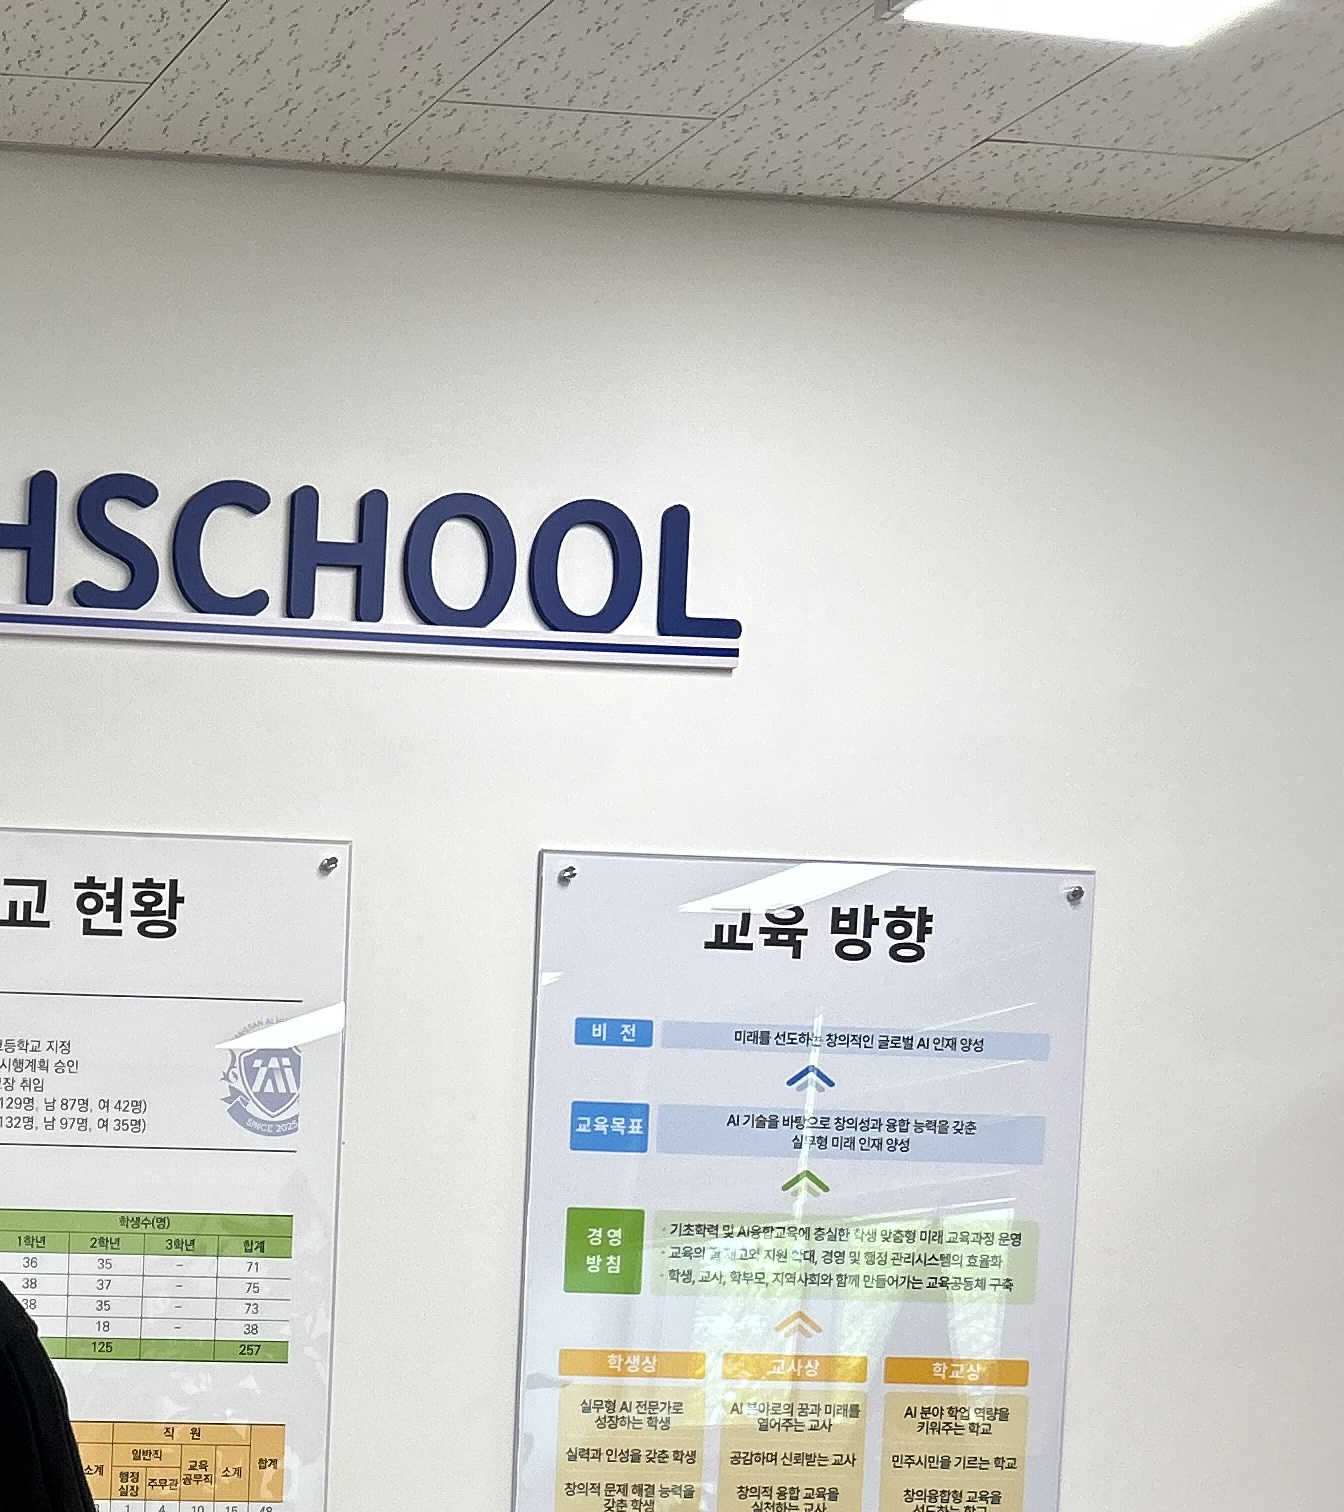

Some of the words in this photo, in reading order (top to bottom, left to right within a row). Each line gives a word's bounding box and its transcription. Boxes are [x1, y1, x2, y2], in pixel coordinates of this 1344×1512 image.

[74, 876, 184, 939] 현황
[704, 905, 809, 960] 교육
[831, 904, 933, 963] 방향
[46, 1040, 71, 1054] 지정
[734, 1030, 770, 1046] 미래를
[826, 1034, 874, 1048] 창의적인
[879, 1035, 913, 1049] 글로벌
[917, 1038, 930, 1049] AI
[933, 1037, 956, 1051] 인재
[961, 1038, 984, 1052] 양성
[0, 1058, 49, 1073] 시행계획
[54, 1059, 78, 1074] 승인
[20, 1078, 44, 1092] 취임
[45, 1098, 56, 1111] 남
[98, 1099, 110, 1112] 여
[44, 1116, 55, 1130] 남
[97, 1118, 109, 1132] 여
[576, 1116, 643, 1136] 교육목표
[726, 1114, 739, 1126] AI
[743, 1114, 779, 1129] 기술을
[834, 1117, 882, 1132] 창의성과
[886, 1118, 910, 1132] 융합
[913, 1119, 949, 1134] 능력을
[952, 1120, 976, 1135] 갖춘
[832, 1136, 855, 1150] 미래
[859, 1137, 882, 1151] 인재
[886, 1138, 910, 1152] 양성
[670, 1223, 719, 1238] 기초학력
[920, 1230, 943, 1244] 미래
[946, 1231, 994, 1246] 교육과정
[998, 1232, 1022, 1246] 운영
[243, 1240, 265, 1254] 합계
[822, 1250, 845, 1265] 경영
[23, 1257, 38, 1268] 36
[97, 1259, 112, 1270] 35
[246, 1262, 260, 1273] 71
[22, 1278, 37, 1289] 38
[96, 1280, 112, 1291] 37
[245, 1283, 260, 1294] 75
[96, 1301, 111, 1312] 35
[244, 1303, 259, 1315] 73
[96, 1321, 110, 1332] 18
[243, 1324, 259, 1335] 38
[91, 1342, 113, 1353] 125
[239, 1344, 261, 1356] 257
[607, 1355, 657, 1372] 학생상
[769, 1360, 820, 1377] 교사상
[933, 1362, 982, 1380] 학교상
[620, 1401, 632, 1412] AI
[635, 1401, 683, 1415] 전문가로
[904, 1406, 916, 1418] AI
[920, 1406, 944, 1420] 분야
[595, 1416, 644, 1429] 성장하는
[647, 1417, 670, 1430] 학생
[808, 1419, 832, 1432] 교사
[917, 1422, 965, 1435] 키워주는
[968, 1423, 992, 1436] 학교
[673, 1450, 696, 1464] 학생
[730, 1451, 777, 1465] 공감하며
[831, 1453, 856, 1467] 교사
[892, 1455, 951, 1469] 민주시민을
[954, 1457, 990, 1470] 기르는
[994, 1457, 1017, 1470] 학교
[564, 1483, 601, 1497] 창의적
[604, 1483, 628, 1497] 문제
[736, 1486, 773, 1500] 창의적
[966, 1491, 1001, 1504] 교육을
[631, 1499, 655, 1512] 학생
